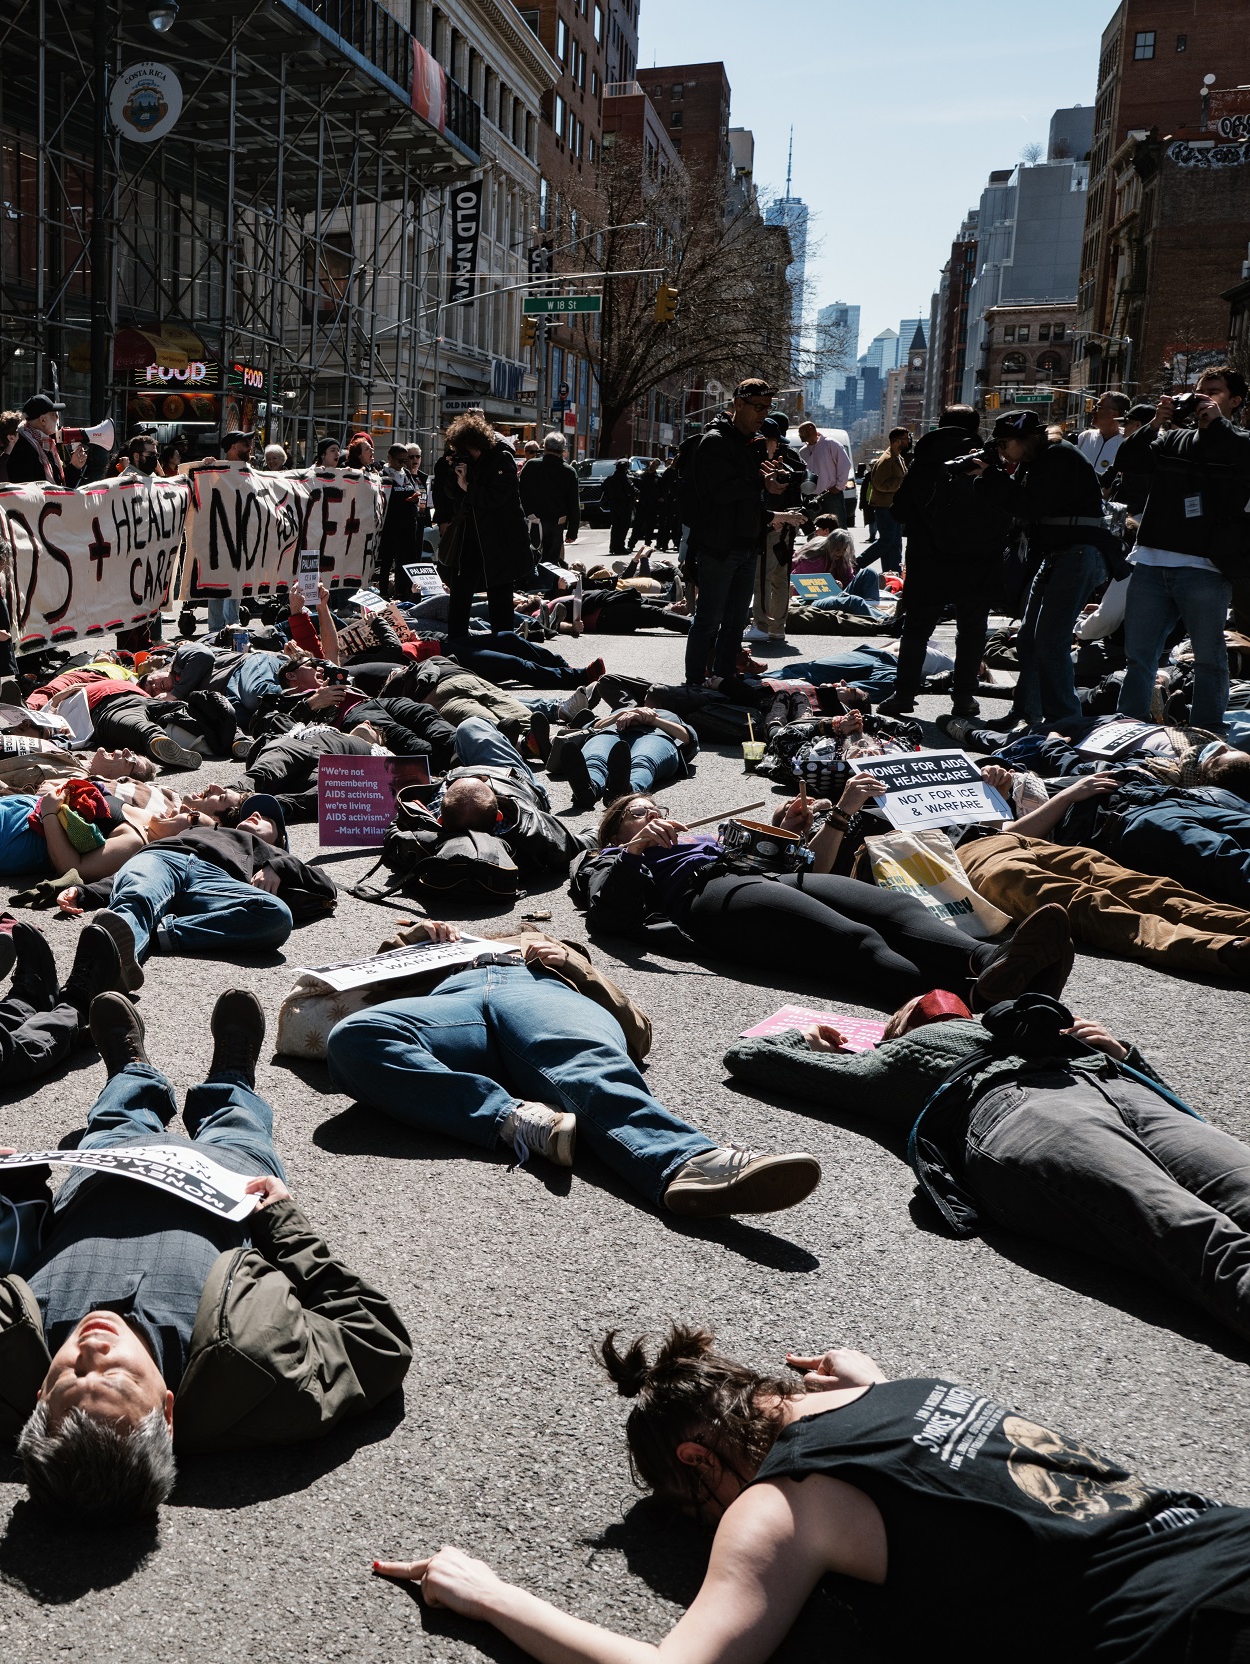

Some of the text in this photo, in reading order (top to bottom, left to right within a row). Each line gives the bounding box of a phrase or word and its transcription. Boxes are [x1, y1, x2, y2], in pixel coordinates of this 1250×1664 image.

[124, 68, 167, 85] COSTA RICA
[453, 191, 477, 300] OLD NAVY
[547, 301, 577, 310] W 18 St
[146, 362, 207, 381] FOOD
[244, 367, 264, 389] FOOD
[461, 401, 481, 409] NAVY
[864, 758, 968, 778] MONEY FOR AIDS
[325, 779, 378, 789] remembering
[893, 770, 972, 787] HEALTHCARE
[325, 790, 384, 799] AIDS activism,
[897, 788, 979, 806] NOT FOR ICE
[325, 801, 371, 812] we’re living
[911, 800, 984, 816] & WARFARE
[348, 813, 390, 821] activism.”
[351, 962, 384, 972] NOT
[387, 950, 473, 970] WARFARE
[60, 1157, 119, 1168] FOR
[129, 1166, 226, 1210] MONEY
[199, 1182, 218, 1195] &
